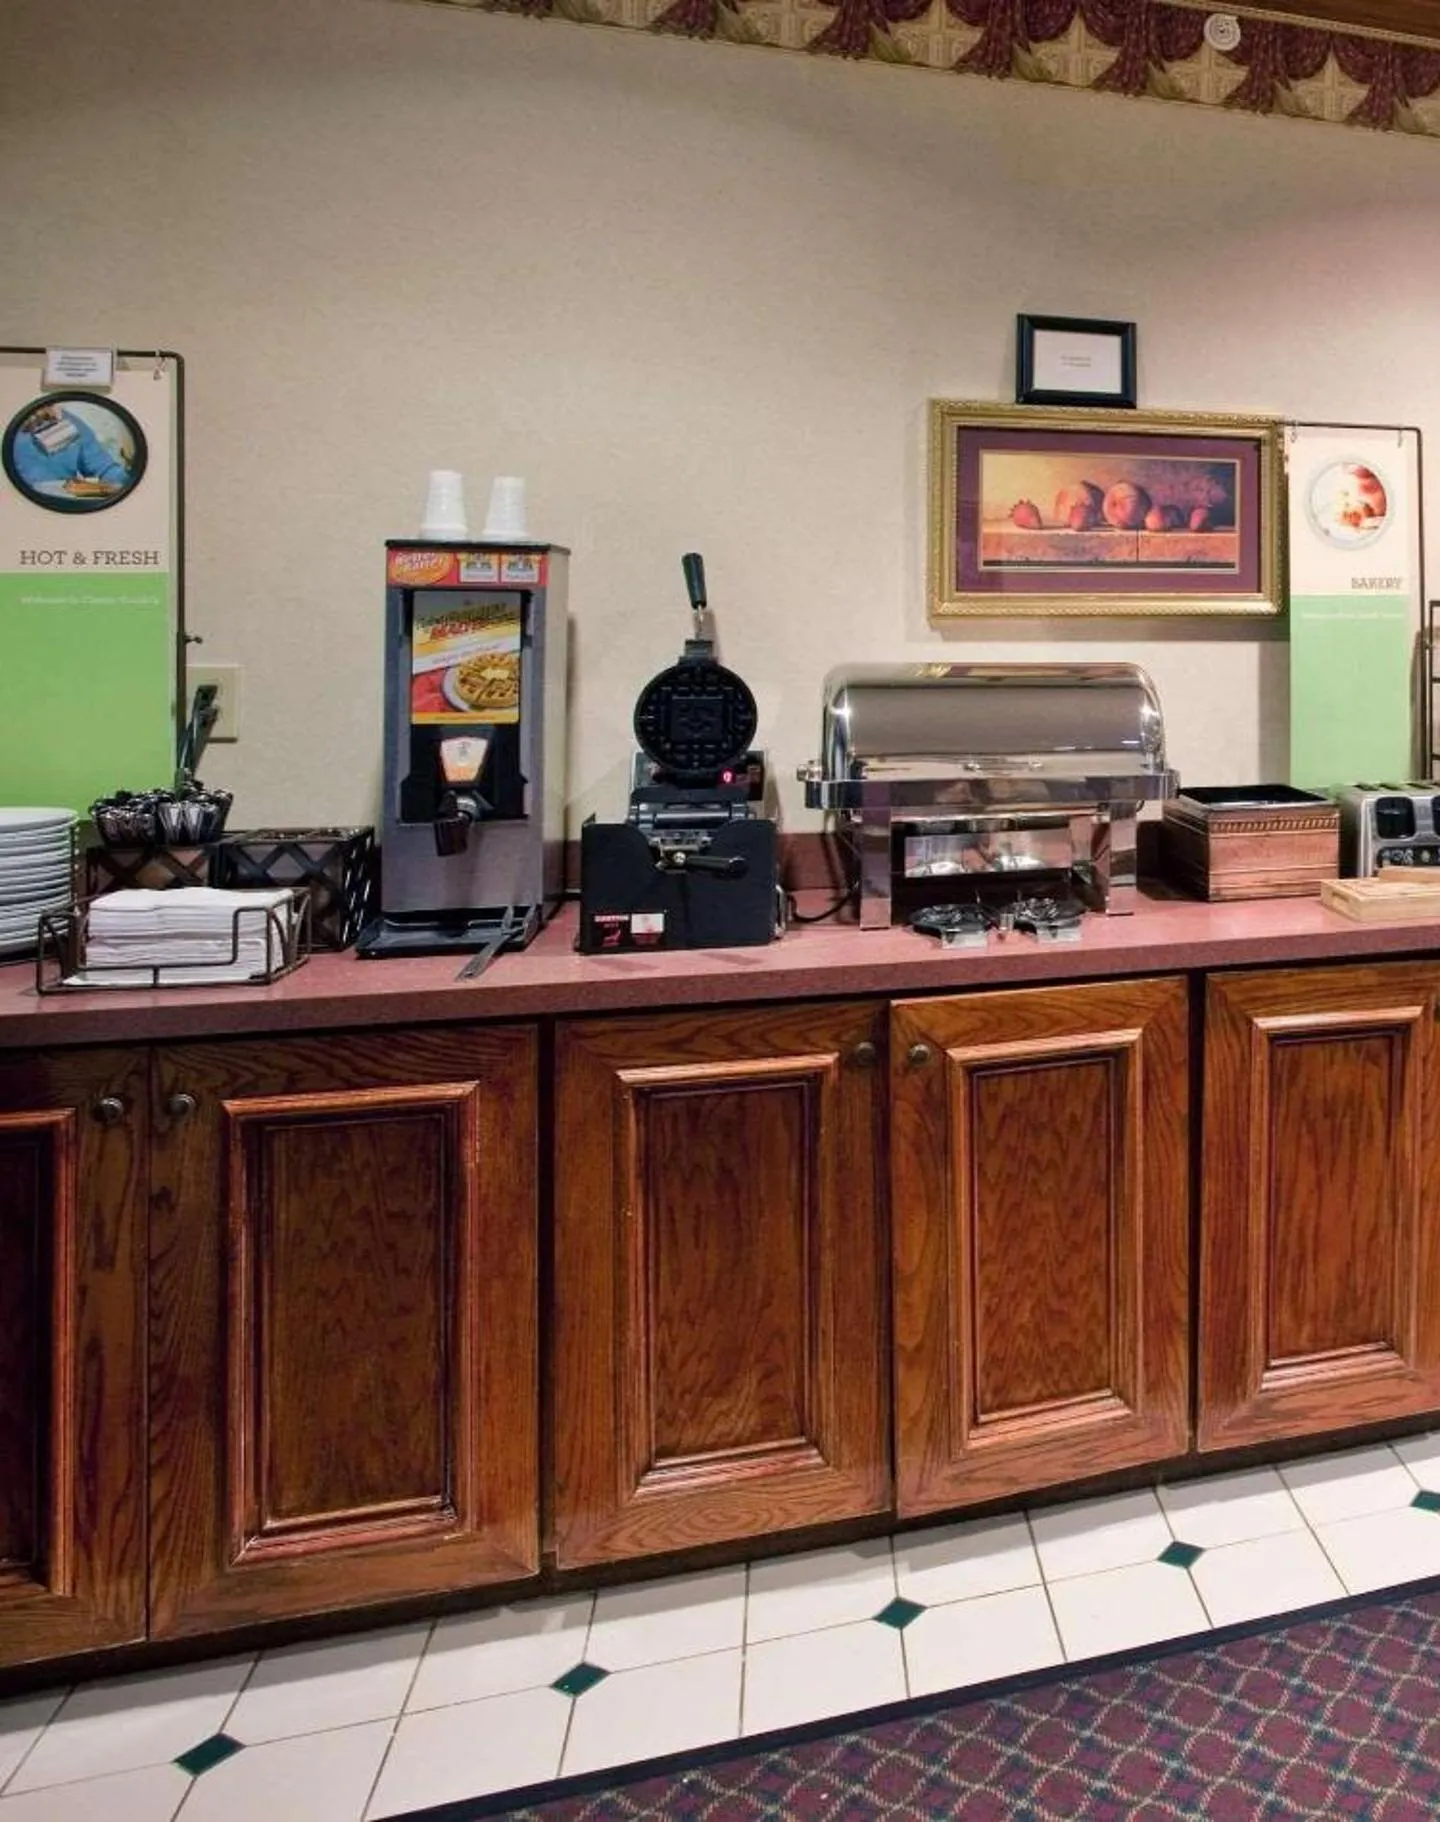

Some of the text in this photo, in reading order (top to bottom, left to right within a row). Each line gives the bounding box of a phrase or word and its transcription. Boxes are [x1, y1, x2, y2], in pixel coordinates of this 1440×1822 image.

[20, 550, 159, 566] HOT & FRESH
[1350, 577, 1402, 590] BAKERY
